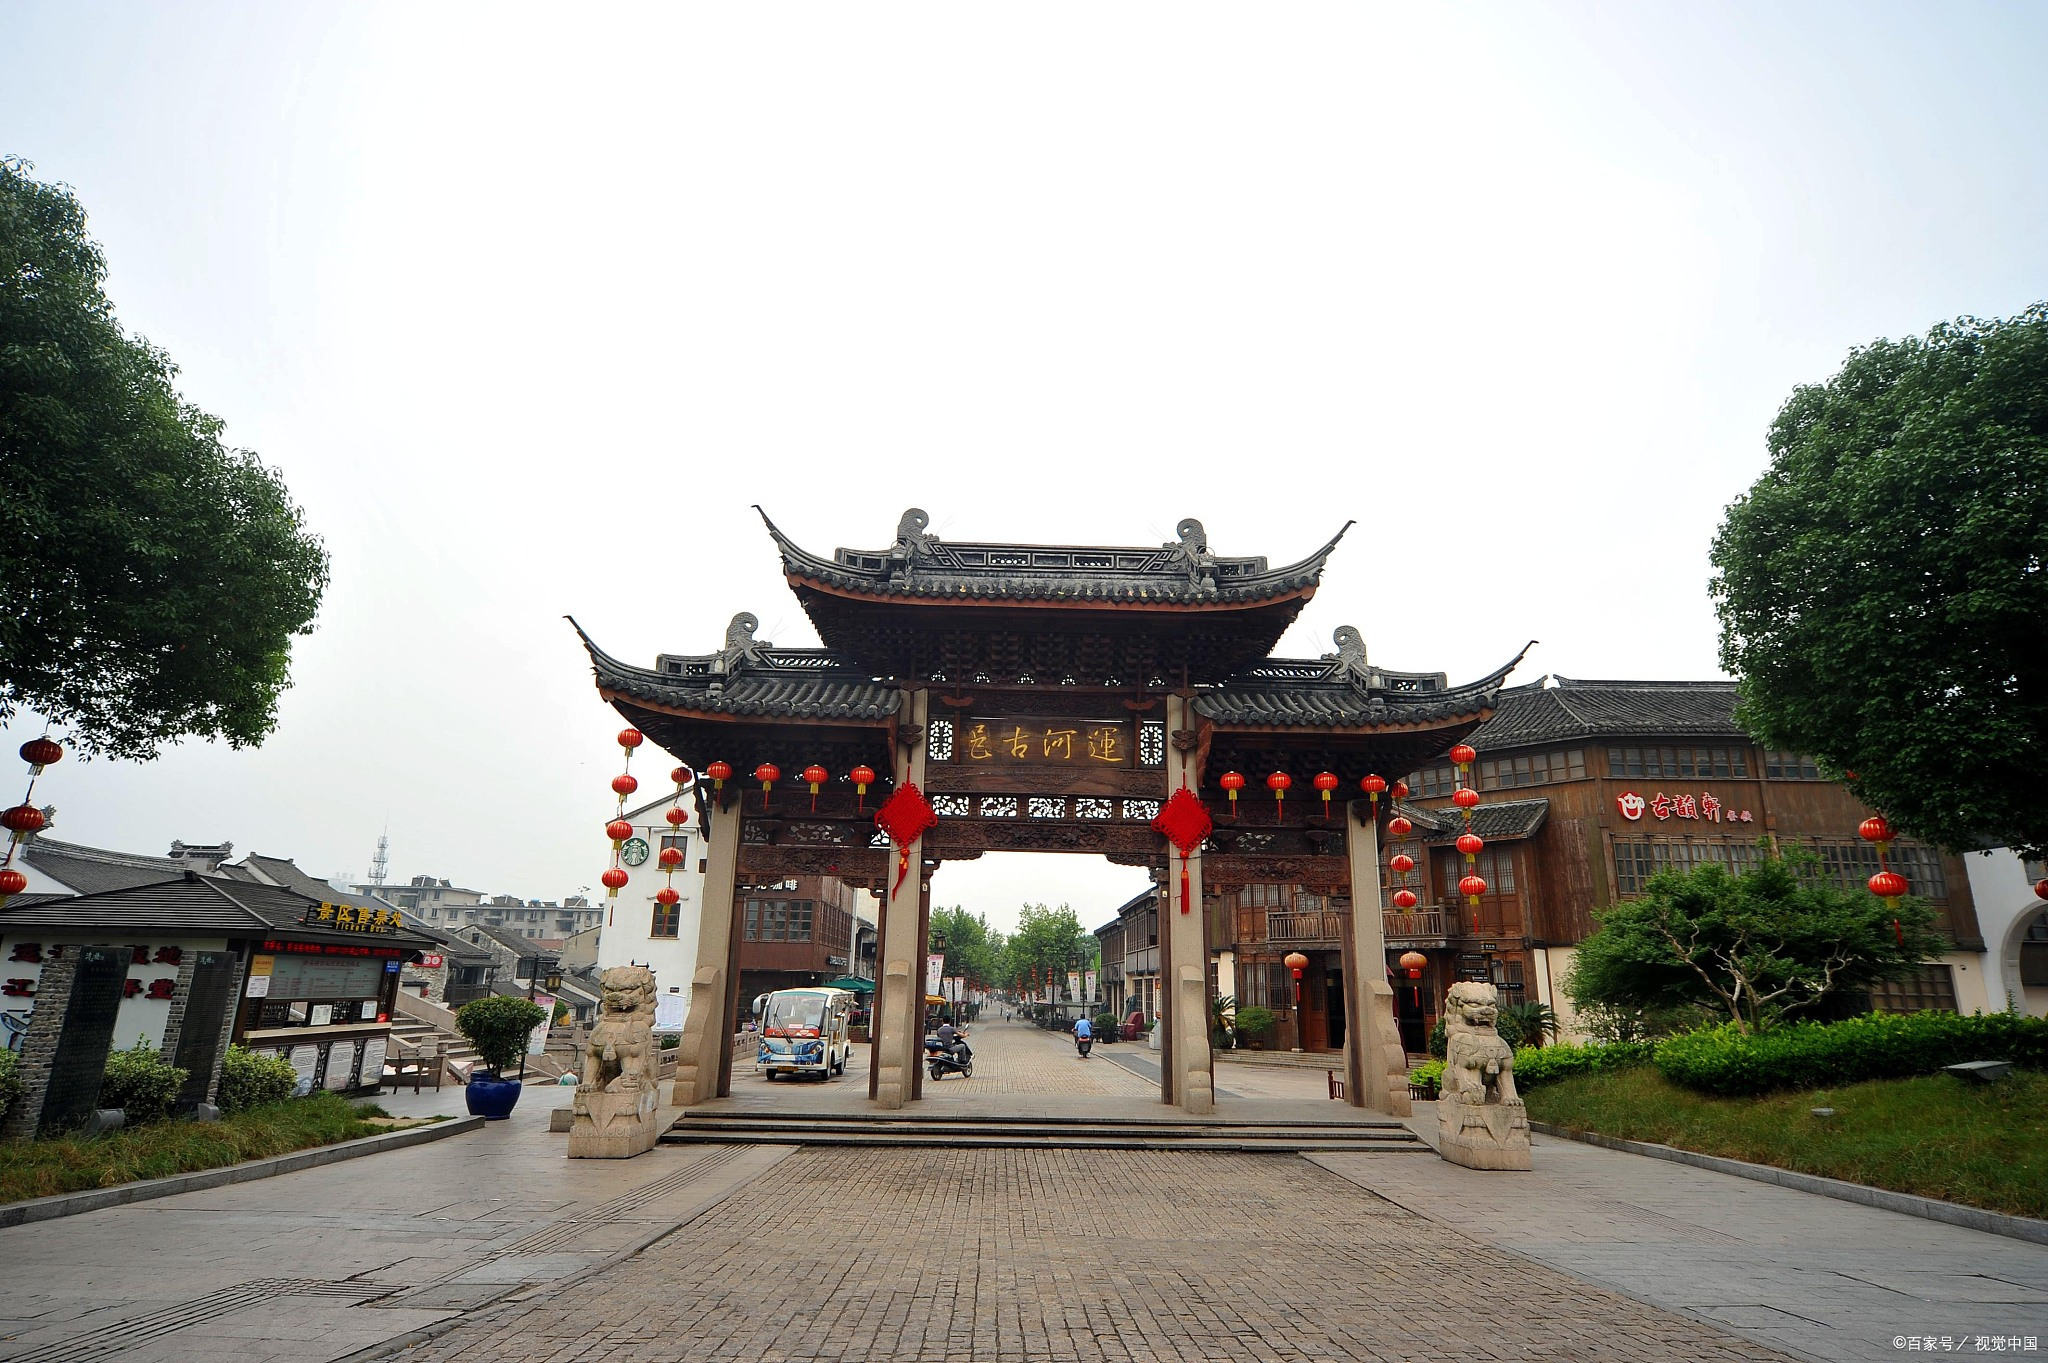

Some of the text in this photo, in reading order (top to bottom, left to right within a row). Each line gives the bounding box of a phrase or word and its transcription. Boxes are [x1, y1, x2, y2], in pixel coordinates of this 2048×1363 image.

[969, 724, 1124, 762] 運河古邑
[316, 901, 403, 928] 景区售票处
[335, 921, 384, 933] Ticket Box
